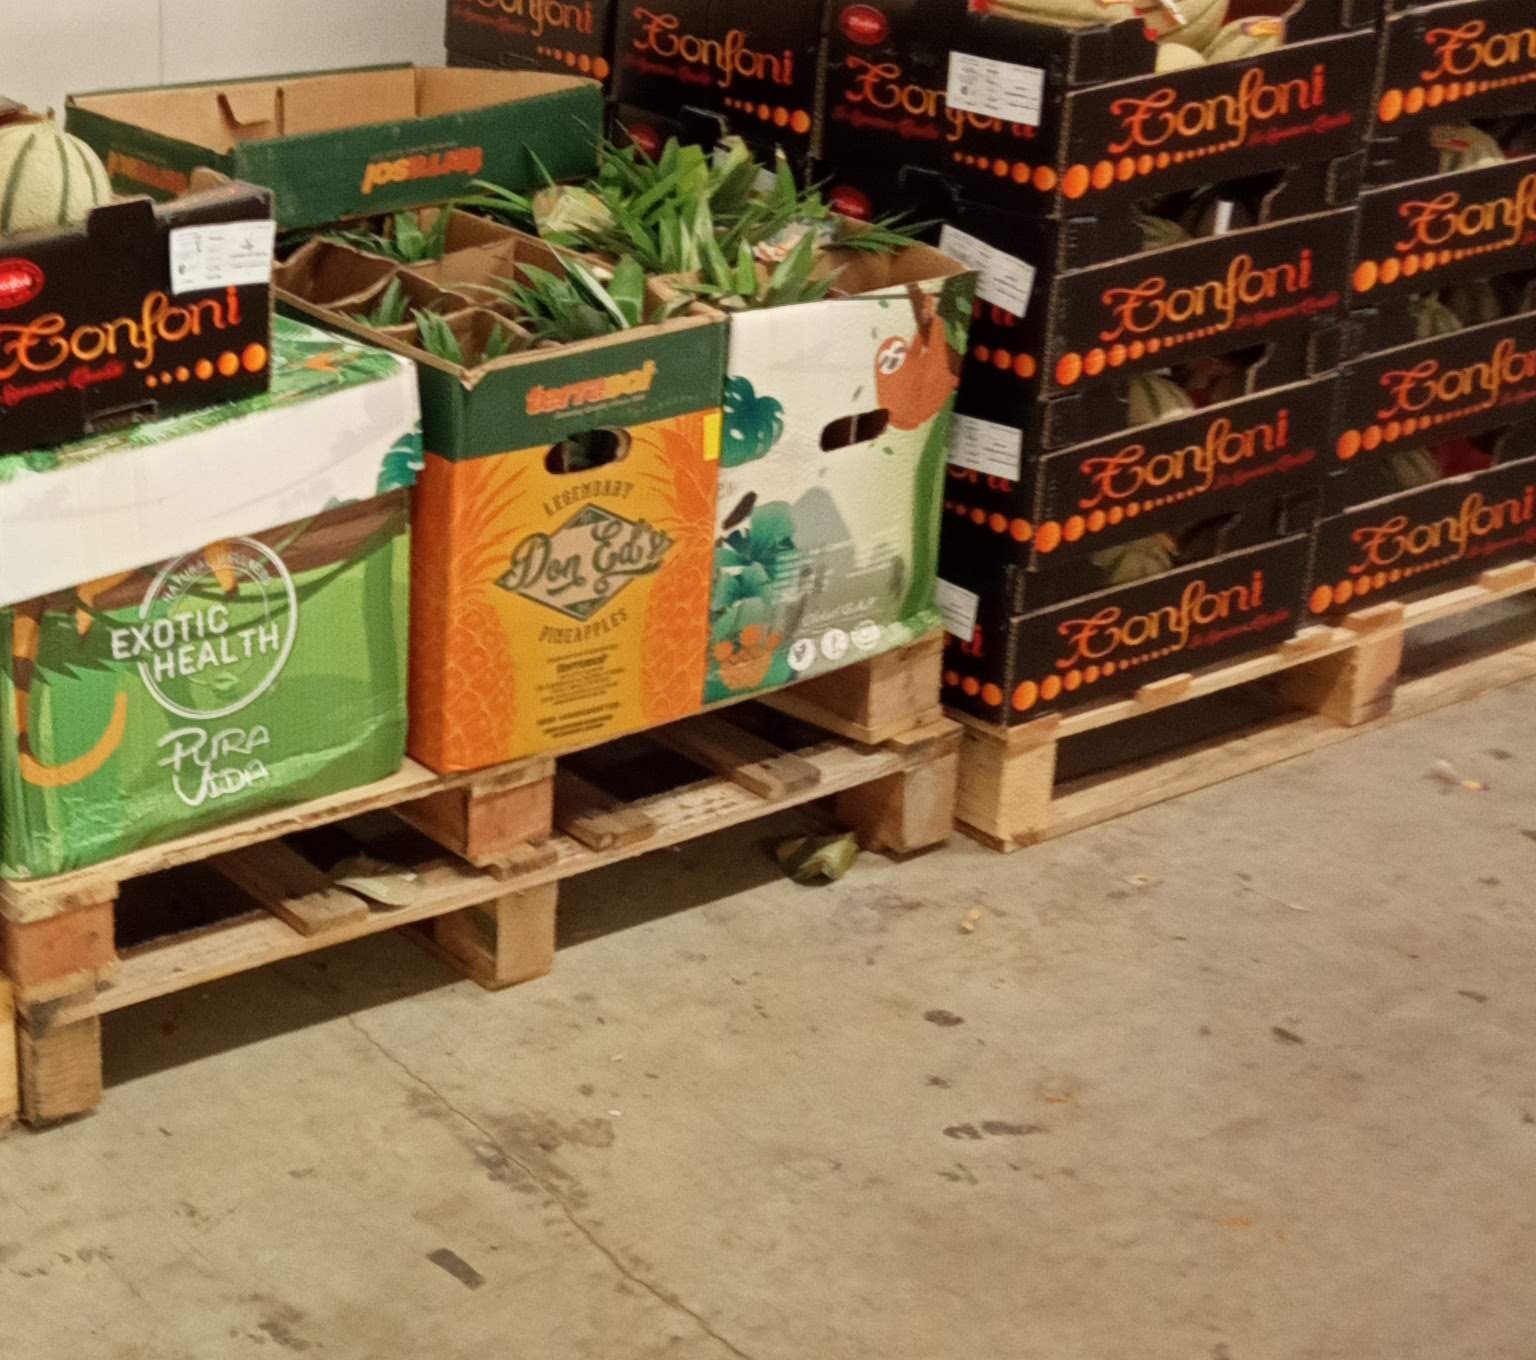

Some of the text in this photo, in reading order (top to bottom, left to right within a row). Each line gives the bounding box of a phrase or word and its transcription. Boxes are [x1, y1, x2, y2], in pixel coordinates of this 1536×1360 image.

[508, 531, 586, 596] Don
[110, 604, 229, 660] EXOTIC
[153, 624, 280, 683] HEALTH
